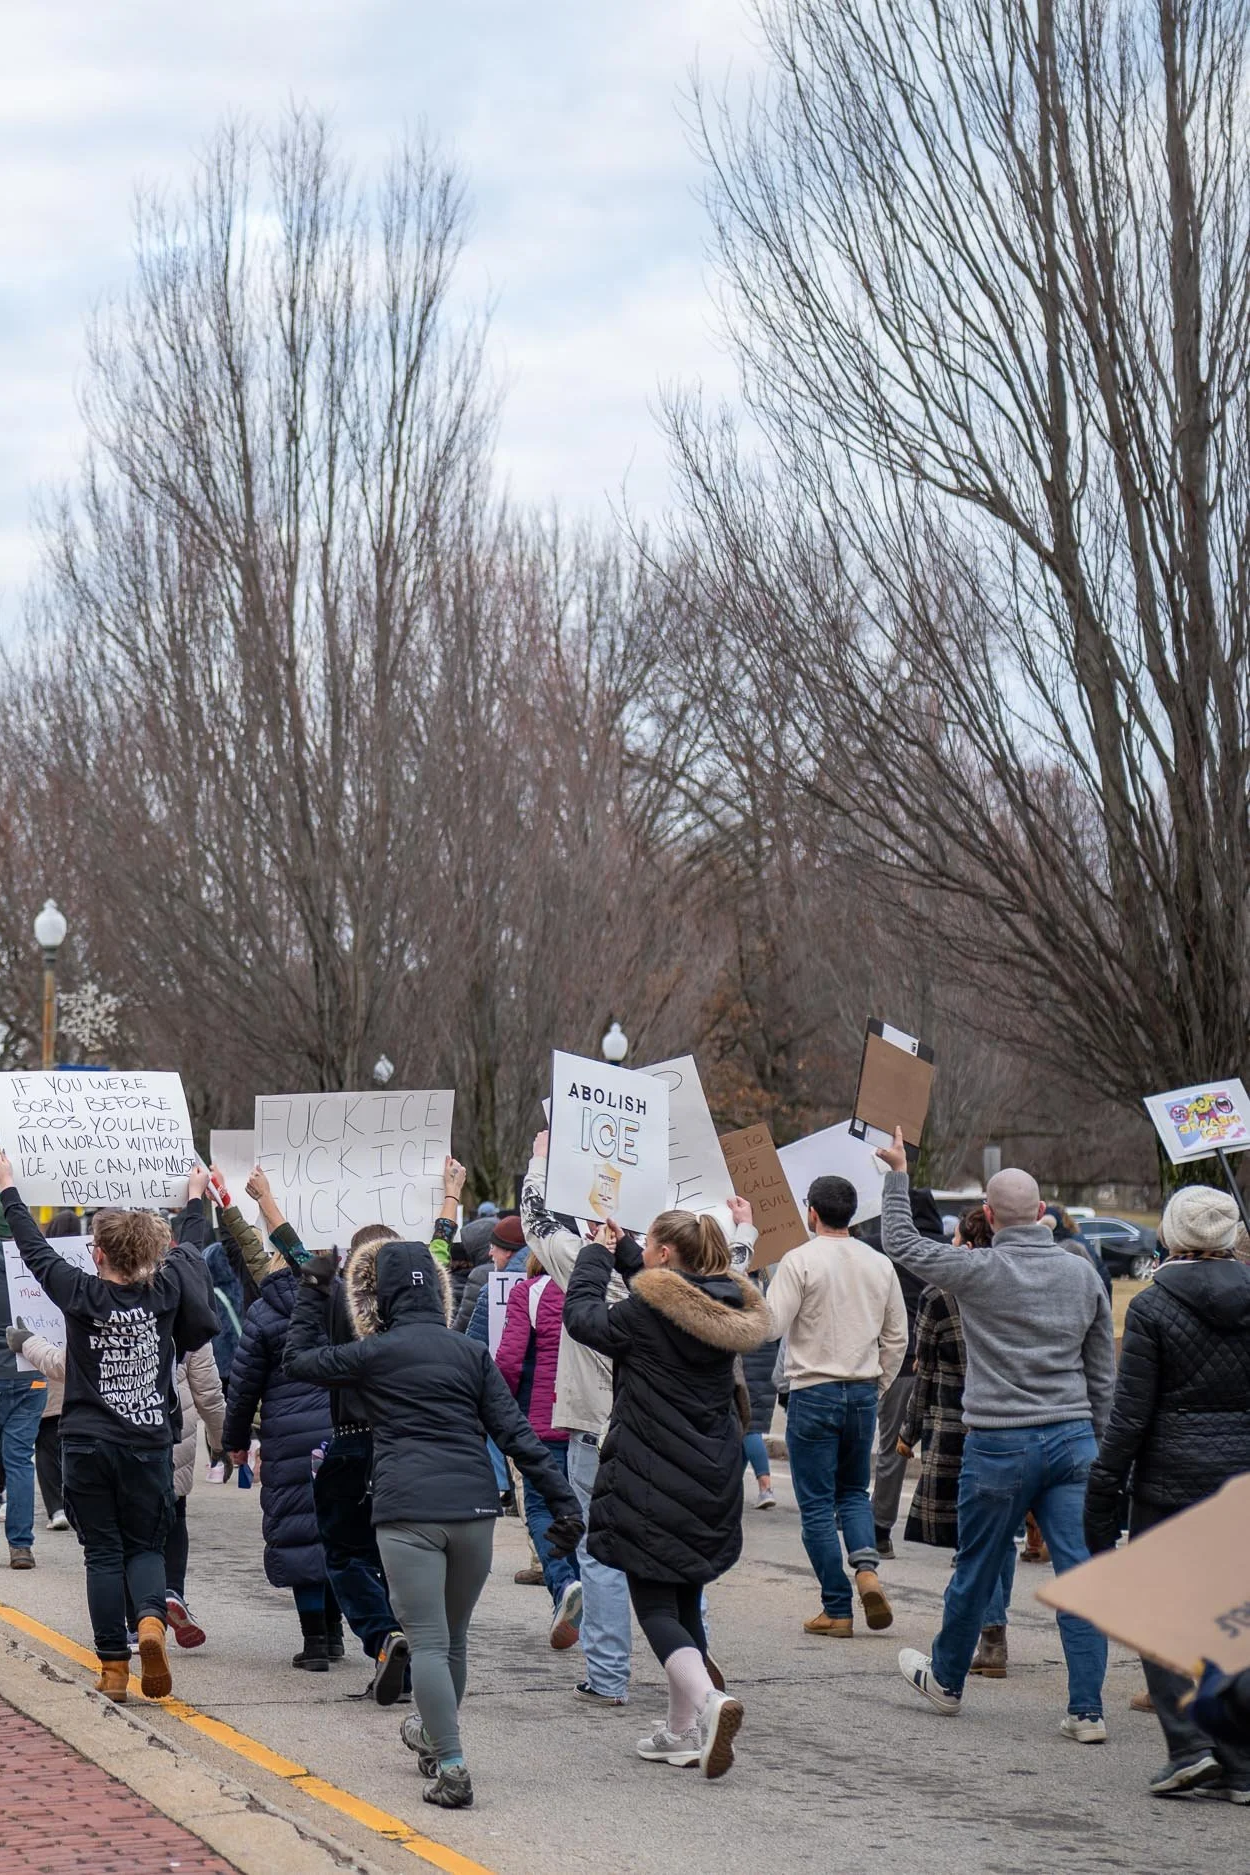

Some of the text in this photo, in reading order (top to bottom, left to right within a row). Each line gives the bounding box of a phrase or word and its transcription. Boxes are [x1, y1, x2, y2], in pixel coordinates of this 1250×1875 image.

[11, 1076, 147, 1096] IF YOU WERE
[12, 1096, 172, 1113] BORN BEFORE
[567, 1082, 647, 1115] ABOLISH
[18, 1115, 87, 1131] 2003,
[261, 1093, 441, 1149] FUCK ICE
[17, 1135, 193, 1156] IN A WORLD WITHOUT
[581, 1106, 641, 1166] ICE
[743, 1134, 764, 1148] TO
[60, 1159, 88, 1177] WE
[95, 1158, 136, 1175] CAN,
[138, 1157, 164, 1173] AND
[165, 1155, 196, 1173] MUST
[256, 1139, 445, 1188] FUCK ICE
[61, 1181, 131, 1204] ABOLISH
[743, 1175, 782, 1194] CALL
[272, 1189, 358, 1234] UCK
[759, 1194, 790, 1212] EVIL
[108, 1307, 147, 1322] ANTI
[89, 1326, 161, 1349] FASCISM
[101, 1343, 159, 1362] ABLEISM
[99, 1354, 160, 1379] HOMOPHOBIA
[98, 1367, 159, 1393] TRANSPHOBIA
